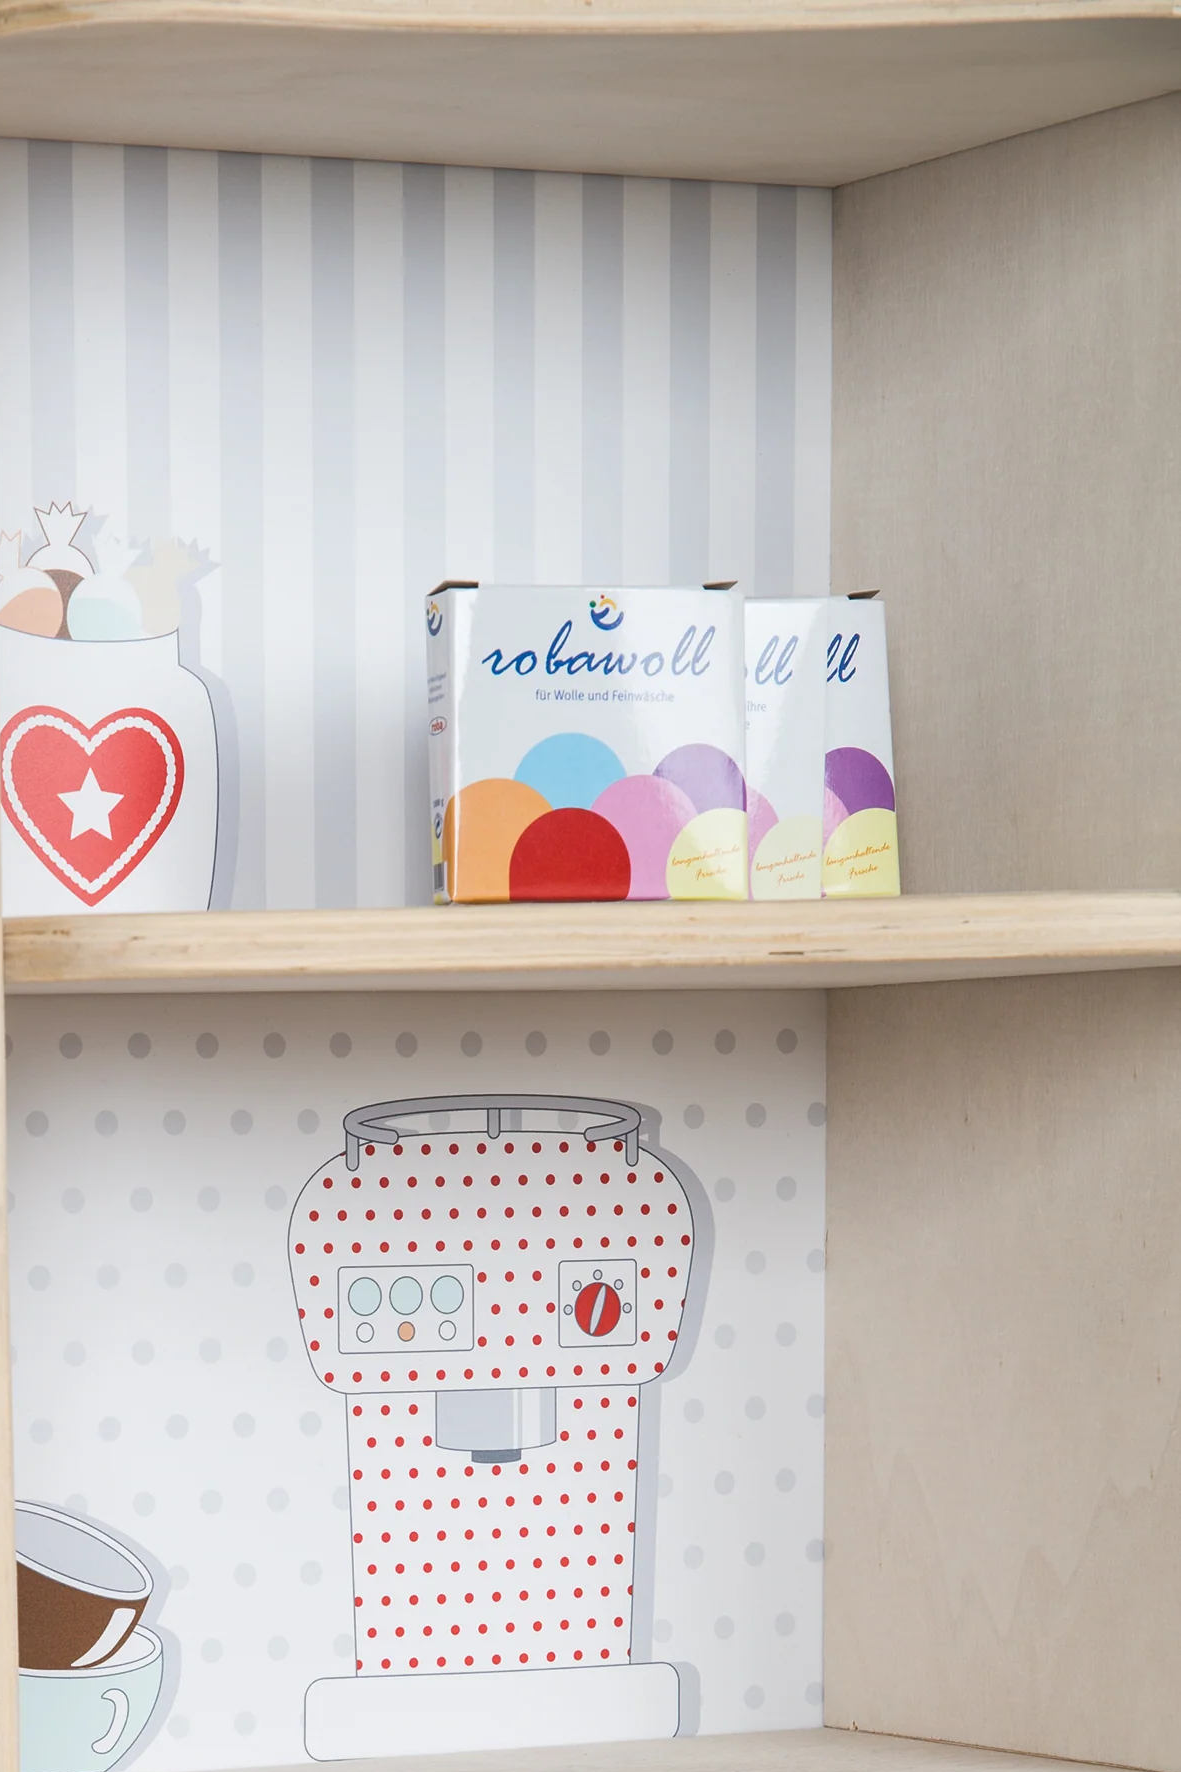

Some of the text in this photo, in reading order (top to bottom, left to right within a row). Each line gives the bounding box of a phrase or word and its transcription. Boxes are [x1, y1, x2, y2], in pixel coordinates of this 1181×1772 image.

[482, 619, 716, 677] robawoll
[744, 634, 799, 685] ll
[535, 688, 675, 703] für Wolle und Feinwäsche
[825, 842, 892, 868] langanhaltende
[848, 863, 879, 880] Frische
